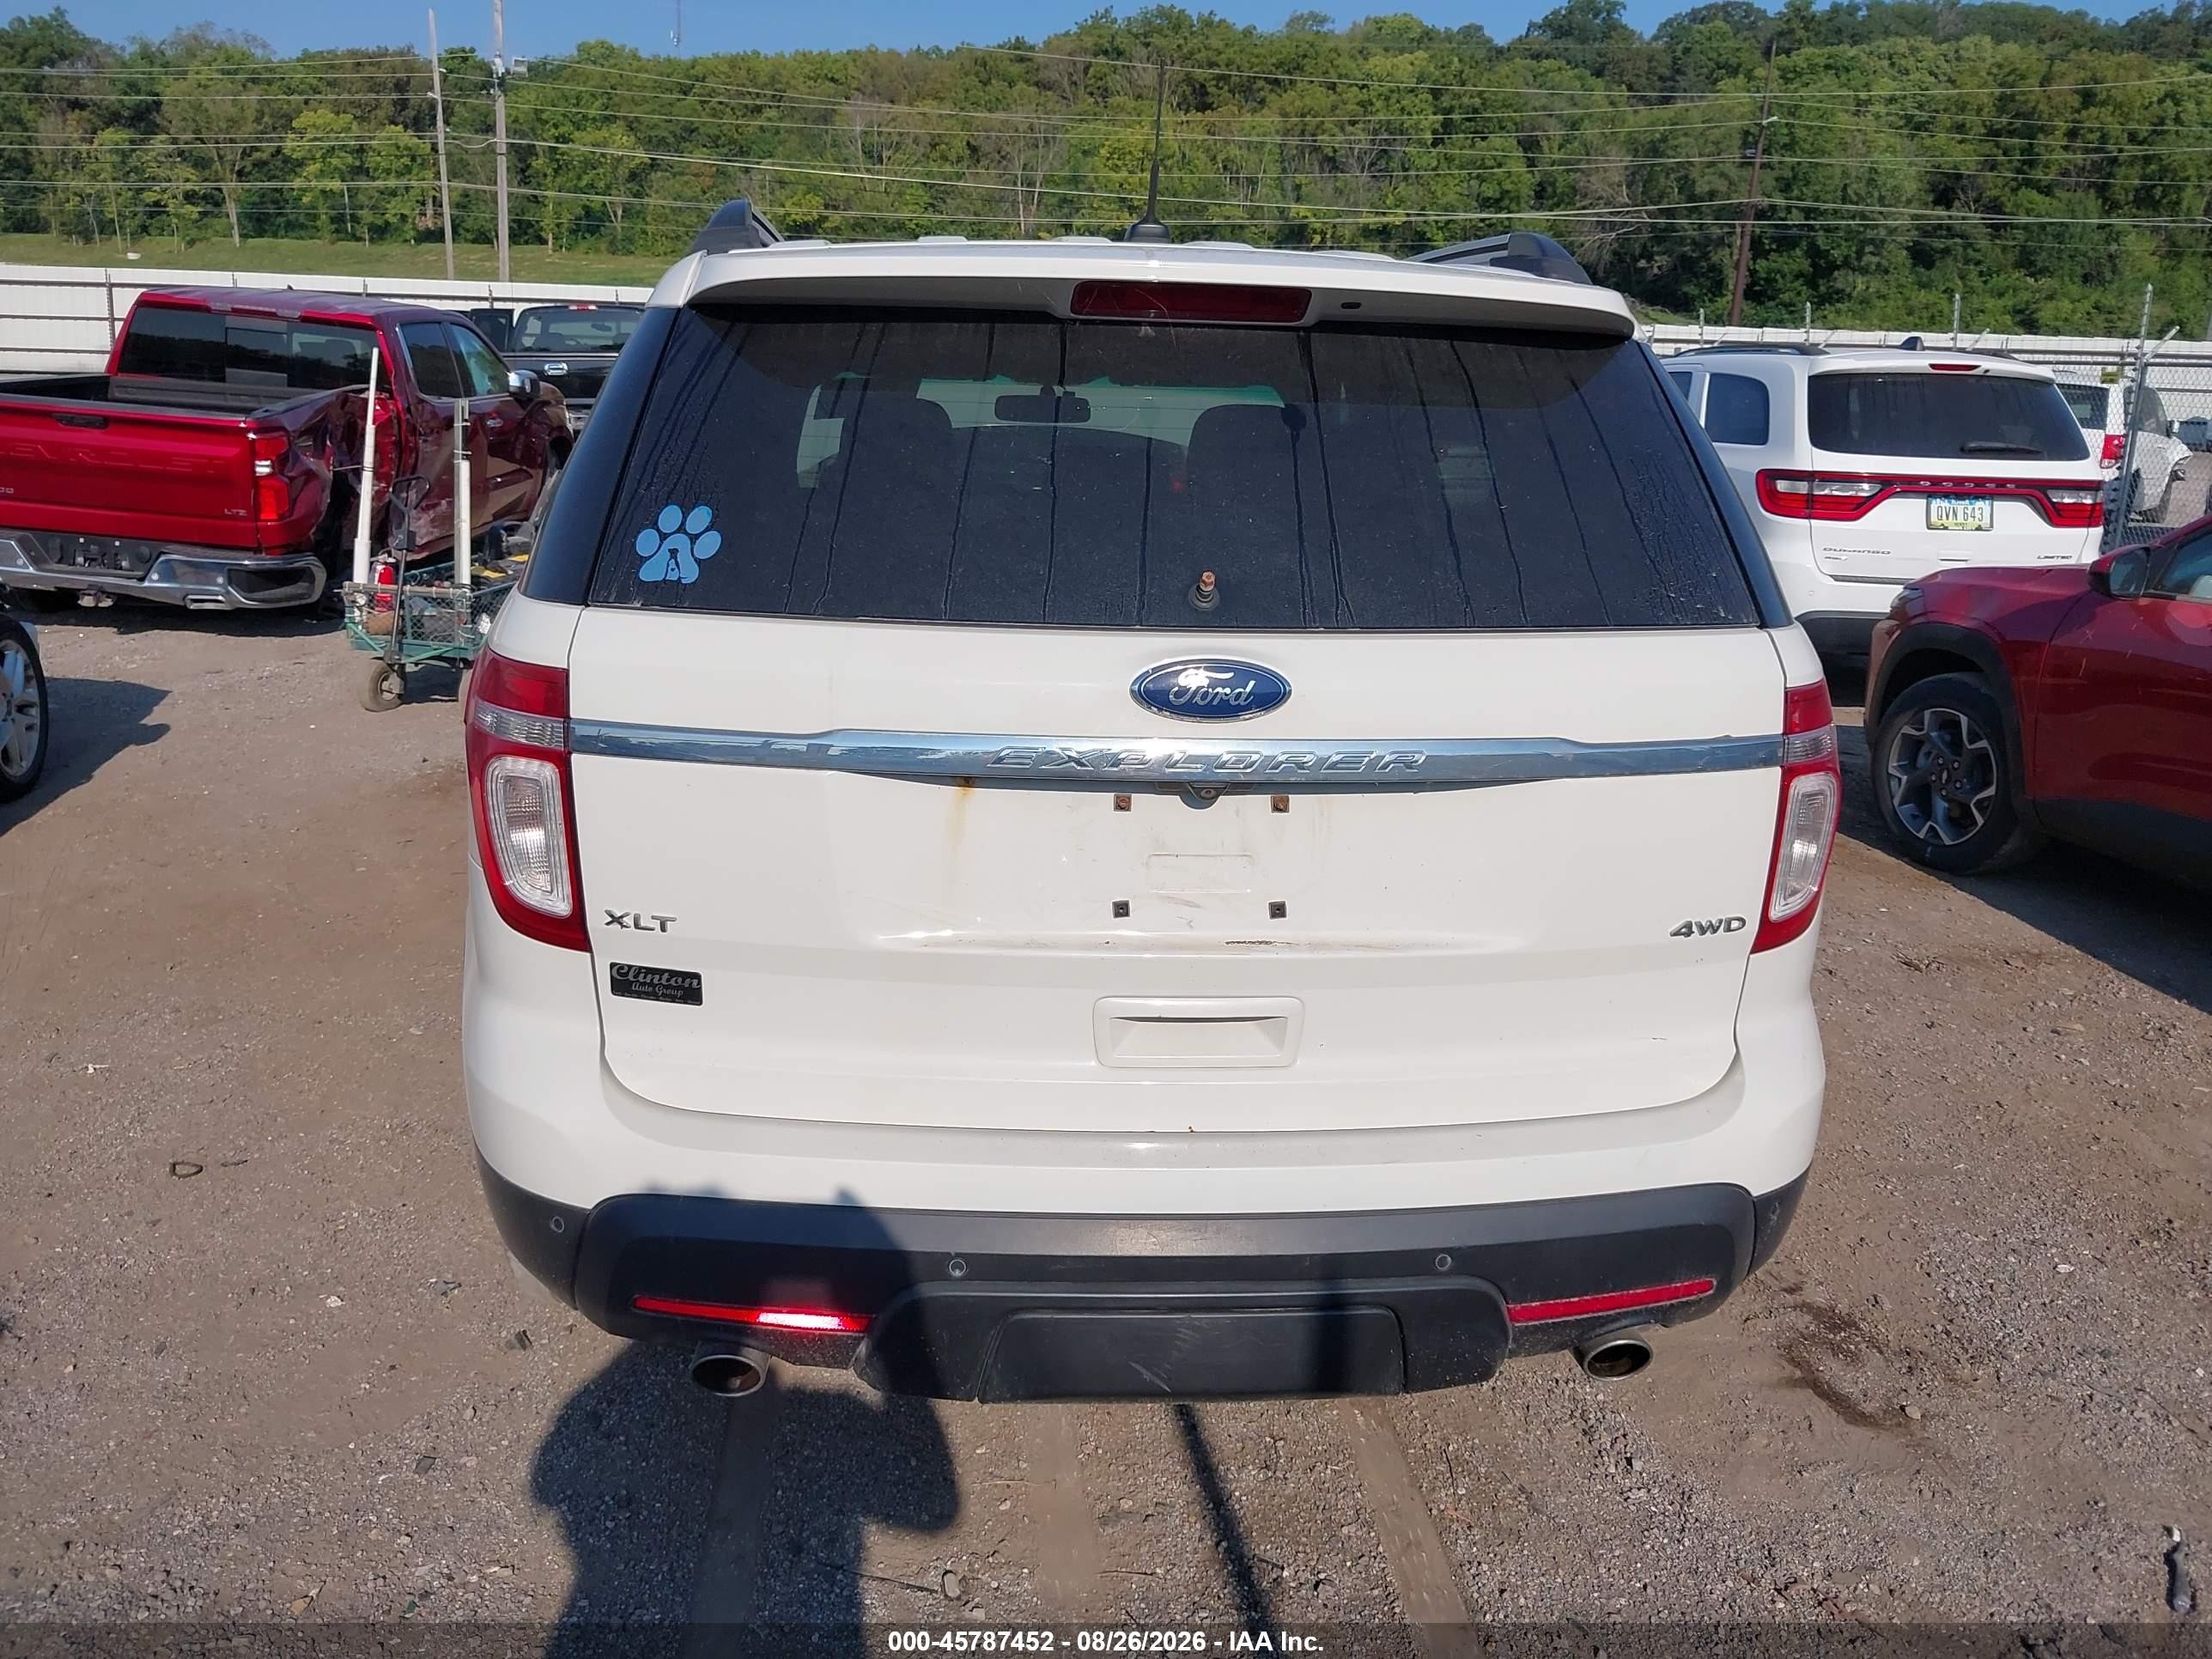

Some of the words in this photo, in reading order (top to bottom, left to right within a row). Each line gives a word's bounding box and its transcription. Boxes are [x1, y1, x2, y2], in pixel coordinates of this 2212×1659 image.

[1936, 505, 1958, 521] QVN
[1963, 507, 1984, 522] 643
[1169, 667, 1256, 706] Ford
[986, 745, 1429, 772] EXPLORER
[604, 909, 677, 933] XLT
[1669, 916, 1747, 938] 4WD
[611, 964, 701, 988] Clinton
[632, 982, 653, 992] Auto
[655, 985, 684, 998] Group
